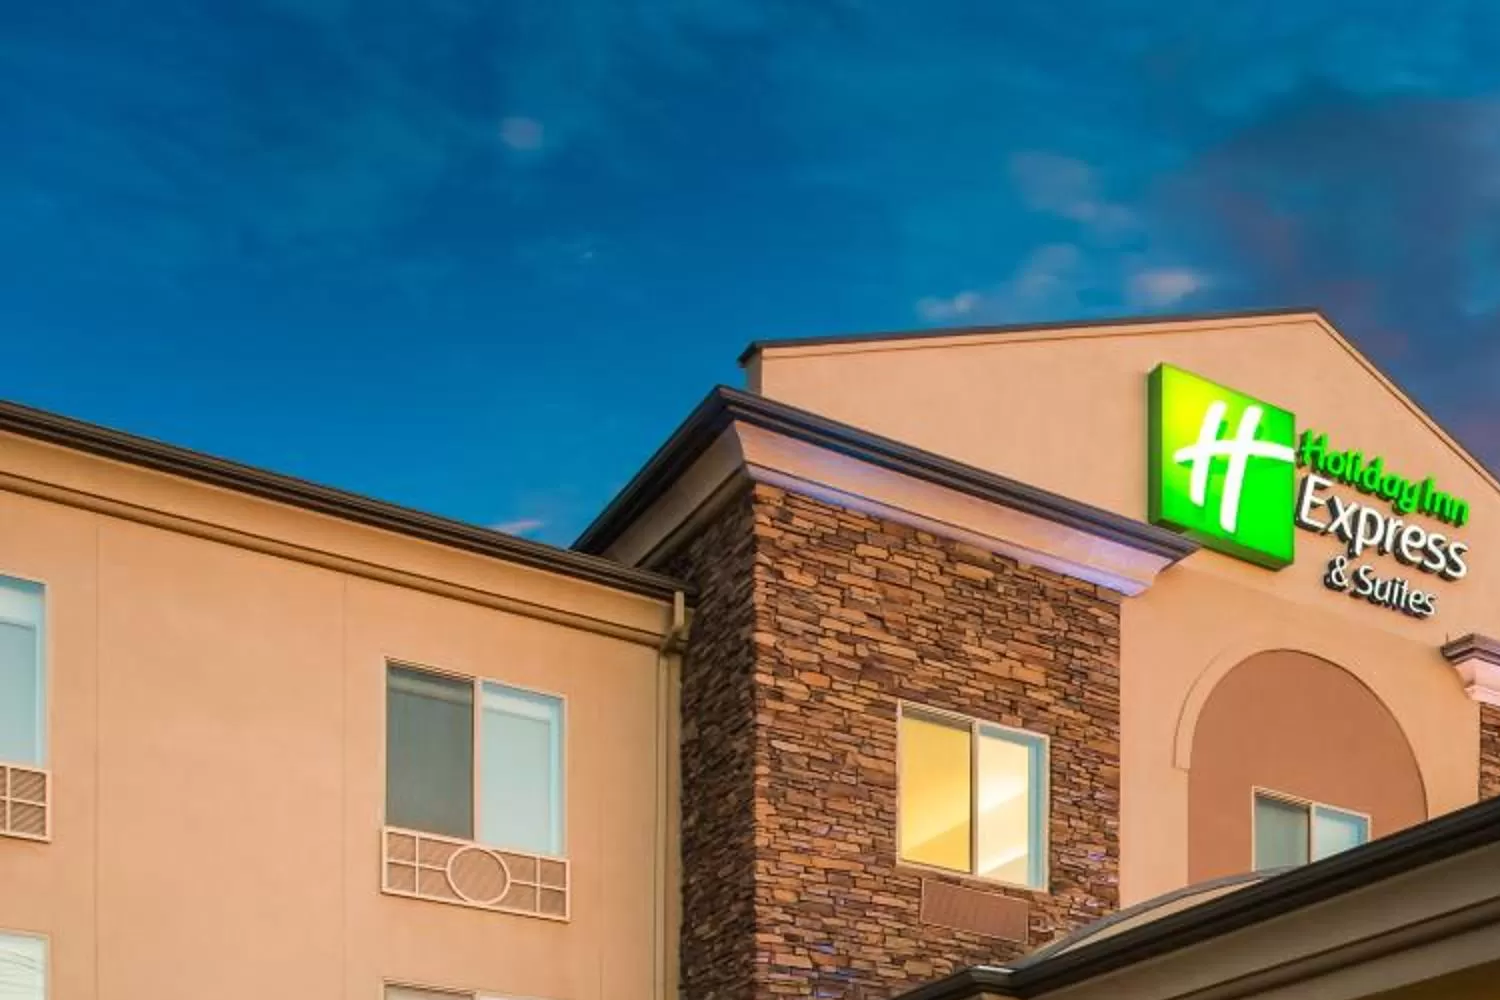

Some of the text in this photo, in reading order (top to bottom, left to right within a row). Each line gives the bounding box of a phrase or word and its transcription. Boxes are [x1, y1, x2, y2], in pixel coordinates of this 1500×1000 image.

[1173, 400, 1295, 534] H
[1299, 429, 1470, 527] Holiday Inn
[1298, 473, 1469, 579] Express
[1327, 555, 1437, 616] & Suites
